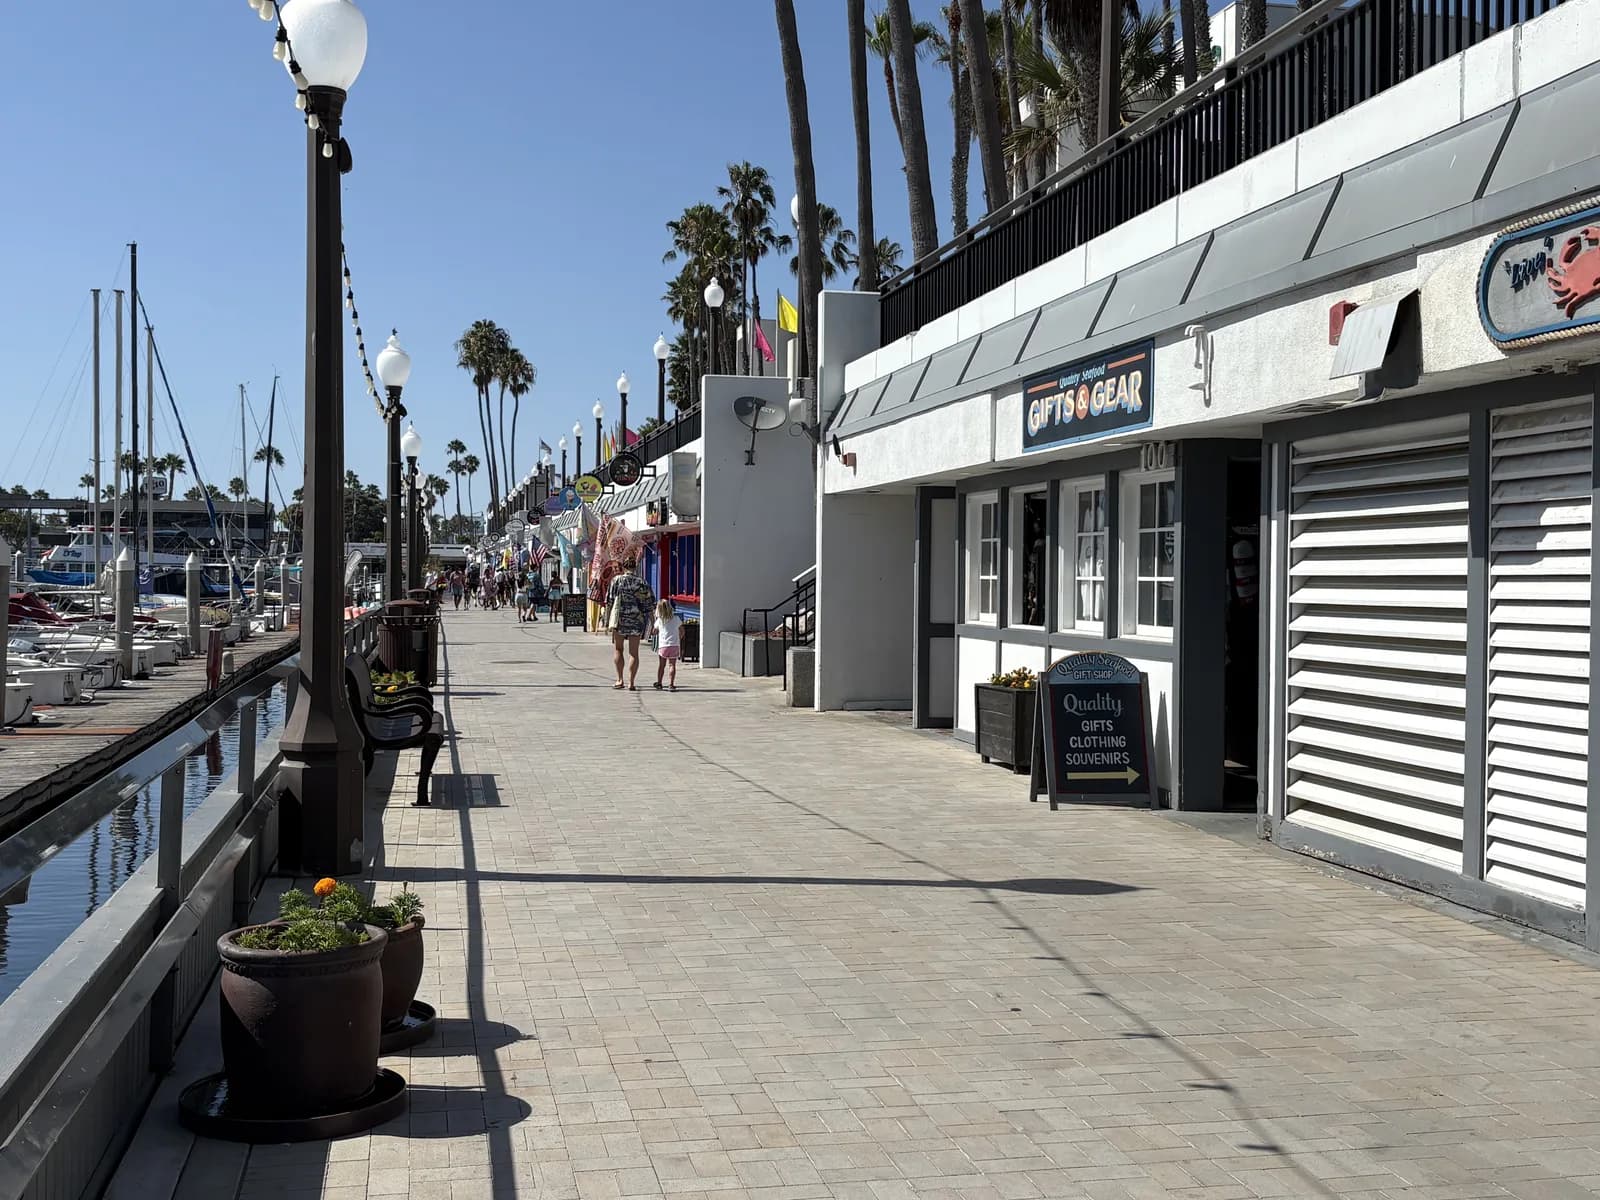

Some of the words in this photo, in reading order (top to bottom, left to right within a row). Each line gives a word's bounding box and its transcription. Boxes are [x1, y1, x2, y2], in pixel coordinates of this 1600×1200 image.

[1059, 372, 1081, 389] Quality
[1082, 362, 1106, 382] Seafood
[1027, 389, 1075, 437] GIFTS
[1077, 390, 1089, 410] &
[1090, 370, 1143, 416] GEAR
[1057, 654, 1095, 675] Quality
[1097, 654, 1135, 678] Seafood
[1073, 669, 1092, 680] GIFT
[1094, 669, 1113, 680] SHOP
[1063, 692, 1122, 717] Quality
[1081, 720, 1114, 732] GIFTS
[1069, 736, 1127, 748] CLOTHING
[1066, 752, 1131, 765] SOUVENIRS
